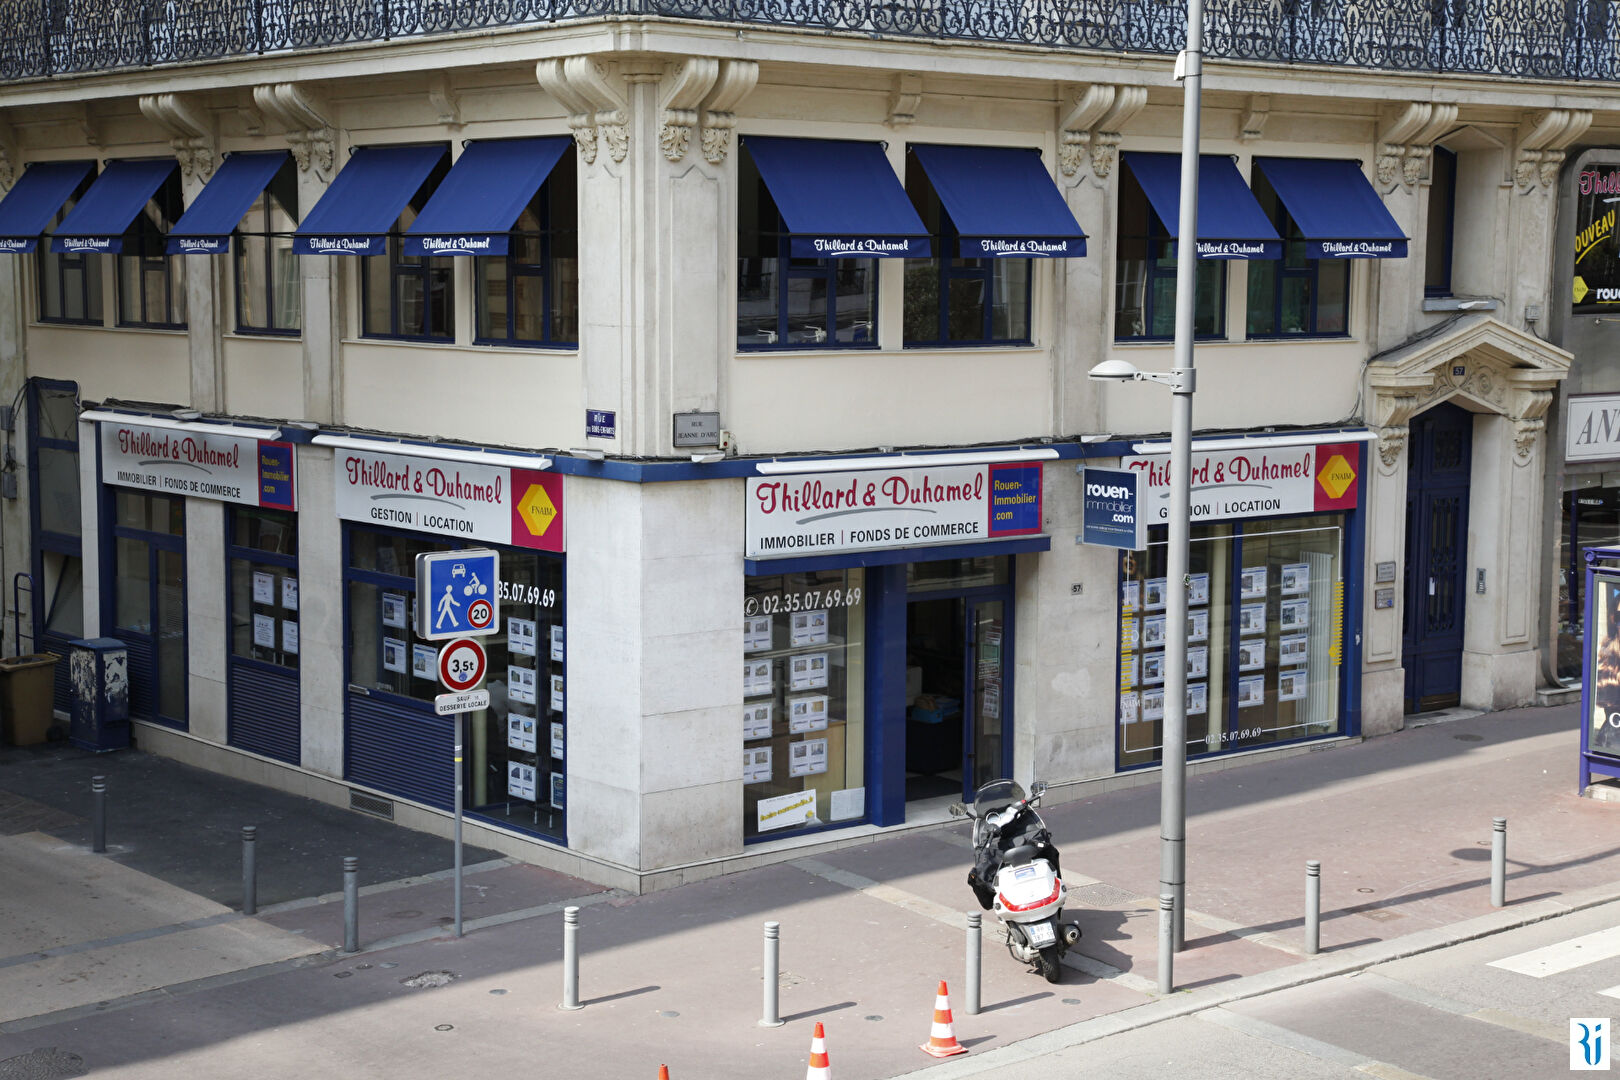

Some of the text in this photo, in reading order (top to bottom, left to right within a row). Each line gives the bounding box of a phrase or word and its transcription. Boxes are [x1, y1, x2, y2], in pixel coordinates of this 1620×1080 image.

[310, 237, 370, 249] Thillard & Duhamel
[423, 237, 489, 249] Thillard & Duhamel
[814, 239, 908, 251] Thillard & Duhamel
[981, 240, 1067, 252] Thillard & Duhamel
[1196, 242, 1264, 253] hillard & Duhamel
[1323, 242, 1392, 253] Thillard & Duhamel
[1597, 288, 1620, 300] rou
[1576, 408, 1620, 445] AN
[118, 428, 239, 468] Thillard & Duhamel
[1214, 460, 1225, 483] &
[1229, 452, 1310, 483] Duhamel
[345, 457, 502, 504] Thillard & Duhamel
[1331, 473, 1352, 482] FNAIM
[117, 471, 241, 498] IMMOBILIER FONDS DE COMMERCE
[994, 480, 1022, 492] Rouen-
[756, 472, 983, 514] Thillard & Duhamel
[1087, 483, 1134, 499] rouen-
[994, 494, 1037, 506] Immobilier
[531, 506, 553, 516] FNAIM
[1224, 499, 1281, 514] LOCATION
[370, 507, 474, 533] GESTION LOCATION
[994, 511, 1013, 521] .com
[1112, 513, 1134, 523] .com
[760, 521, 979, 550] IMMOBILIER FONDS DE COMMERCE
[763, 587, 862, 614] 02.35.07.69.69
[473, 608, 488, 620] 20
[452, 659, 474, 674] 3,5t
[456, 694, 471, 703] SAUF
[439, 699, 488, 712] DESSERTE LOCALE
[1205, 727, 1262, 744] 02.35.07.69.69
